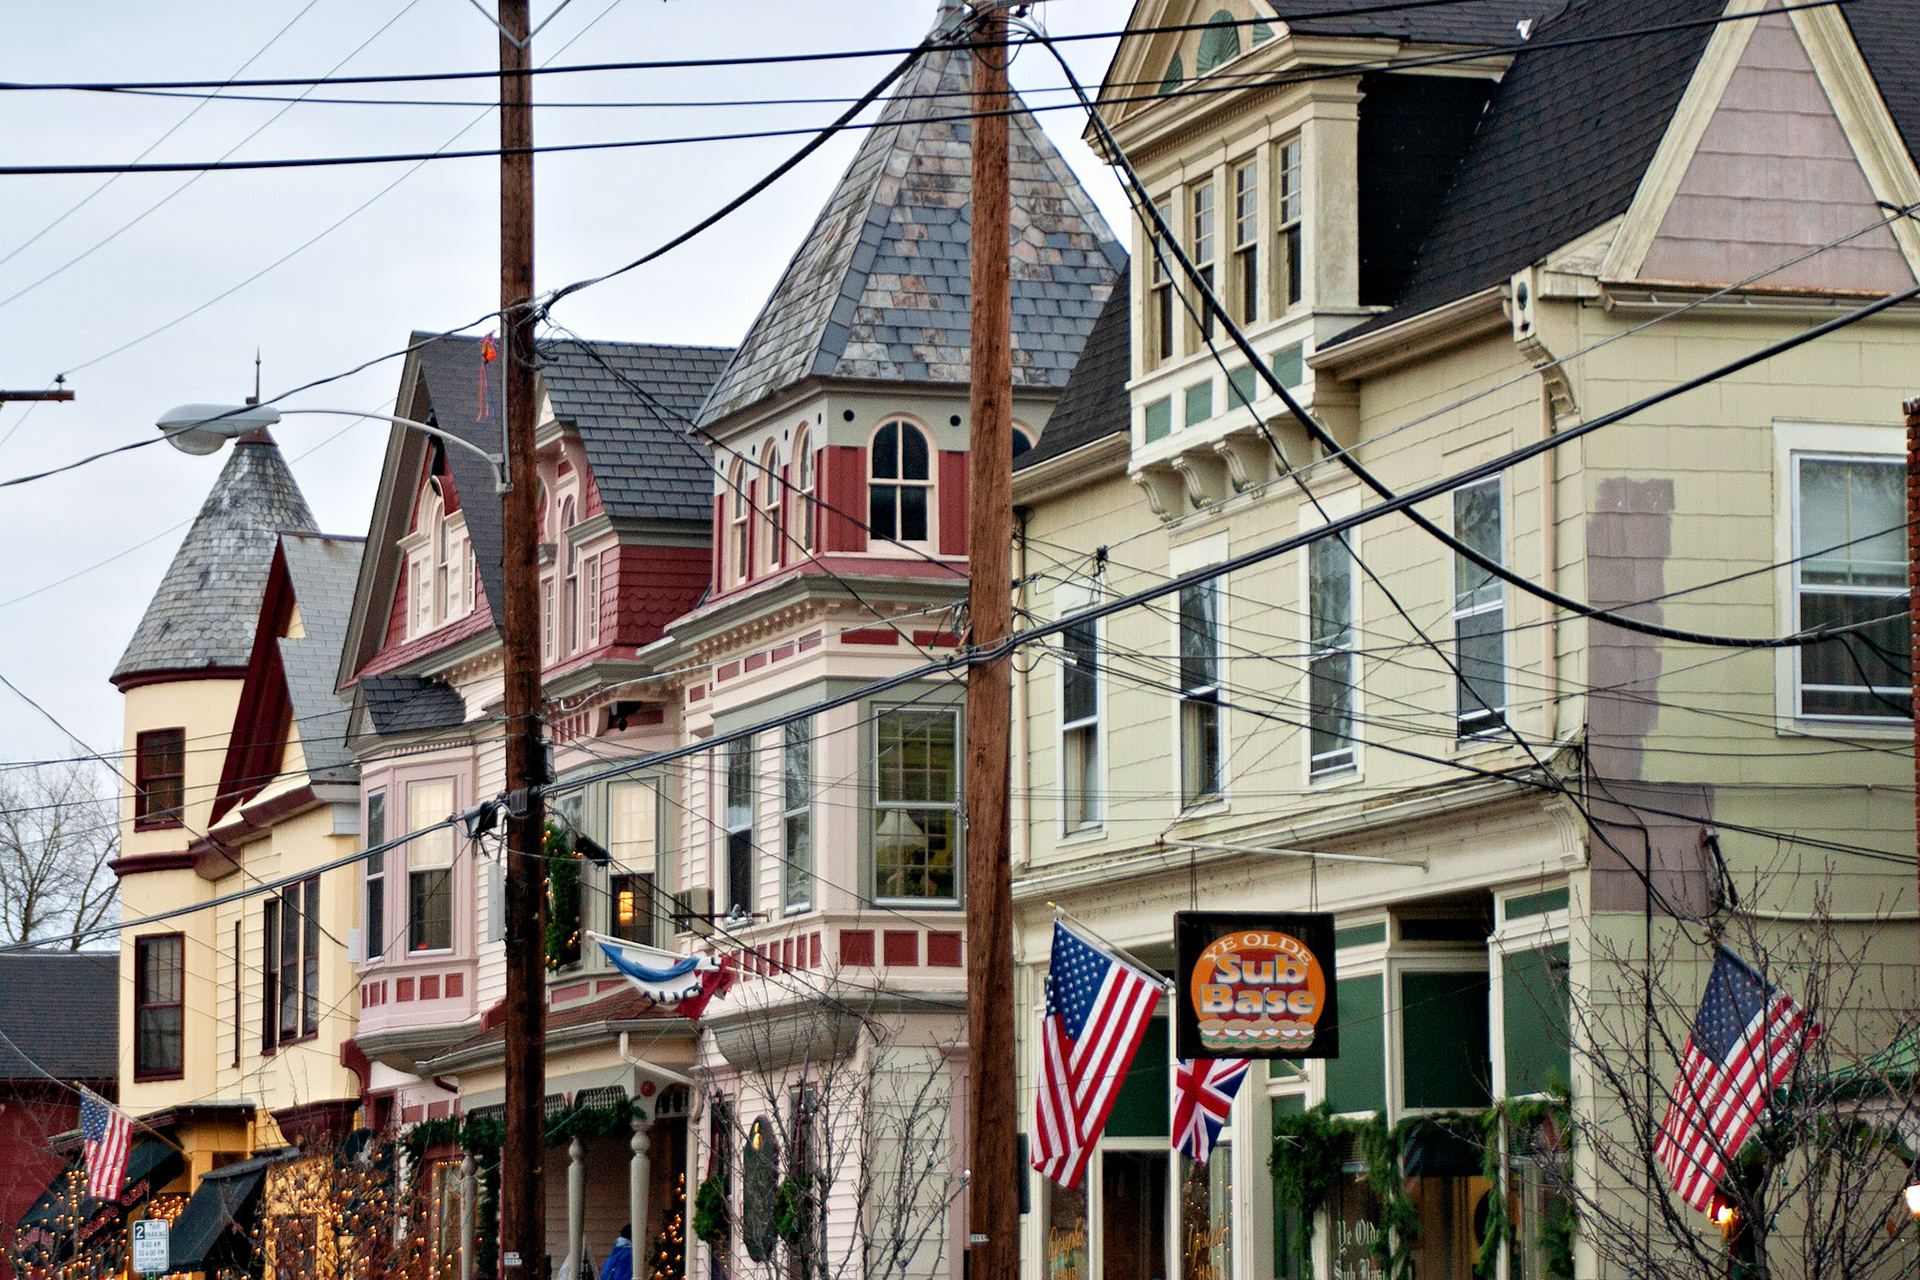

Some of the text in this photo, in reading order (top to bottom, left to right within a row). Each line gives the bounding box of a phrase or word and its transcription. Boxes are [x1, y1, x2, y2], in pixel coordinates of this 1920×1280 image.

[1203, 933, 1312, 967] YE OLDE
[1215, 953, 1308, 985] Sub
[1201, 983, 1316, 1014] Base
[136, 1225, 144, 1239] 2
